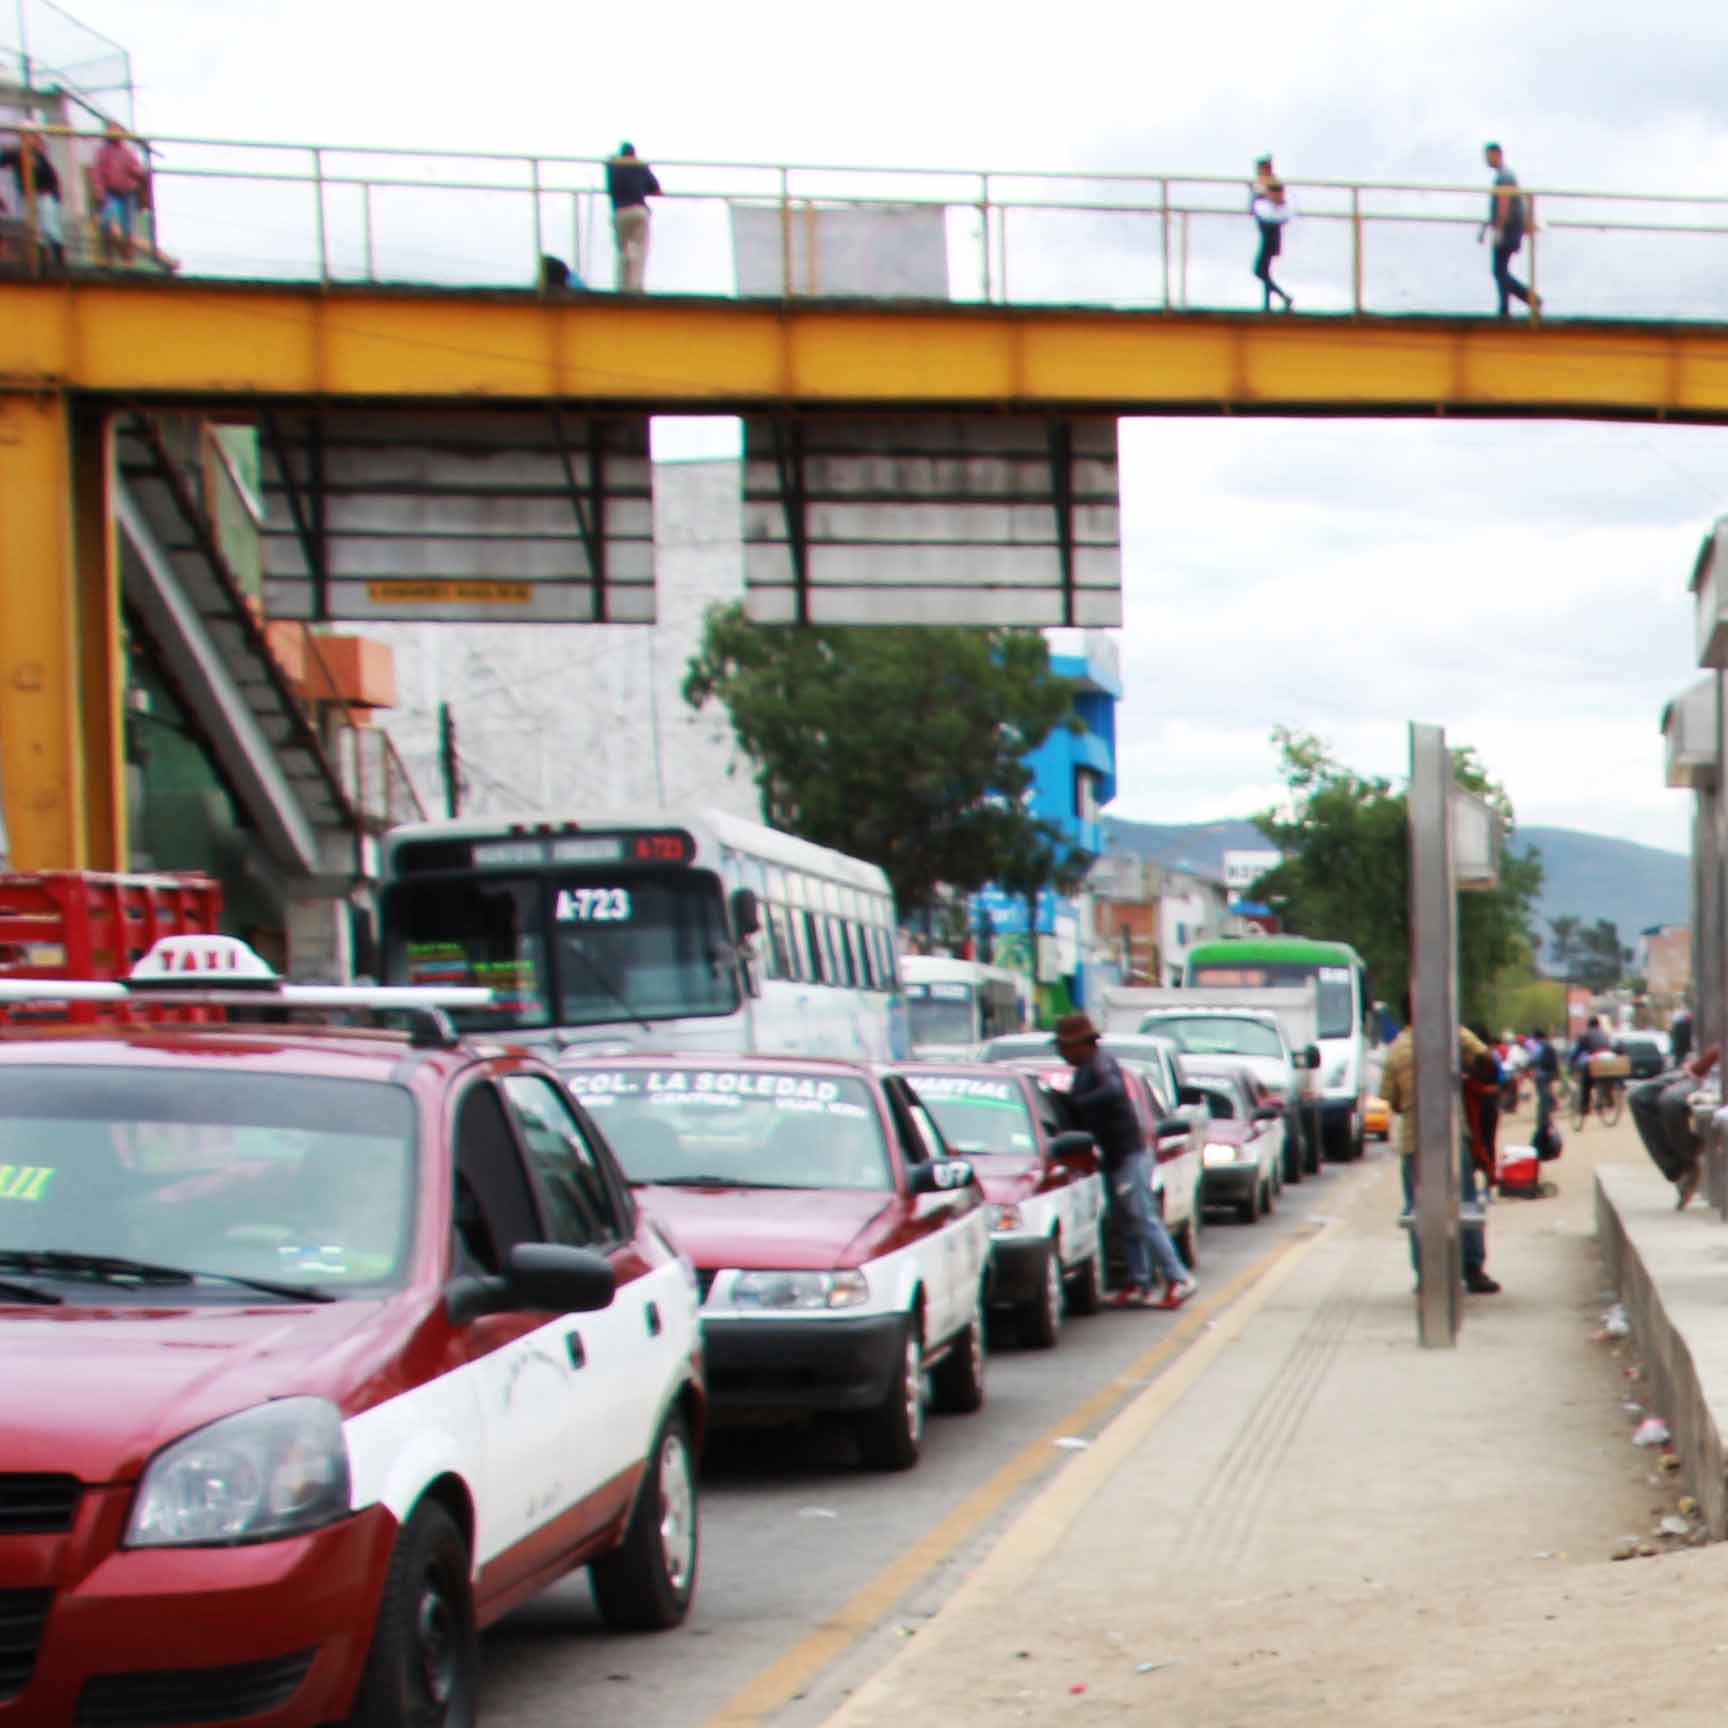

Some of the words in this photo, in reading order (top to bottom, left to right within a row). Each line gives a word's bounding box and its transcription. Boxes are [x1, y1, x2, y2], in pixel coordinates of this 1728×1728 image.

[555, 888, 631, 921] A-723
[159, 950, 237, 971] TAXI
[568, 1075, 638, 1095] COL.
[647, 1072, 688, 1093] LA
[695, 1073, 839, 1101] SOLEDAD
